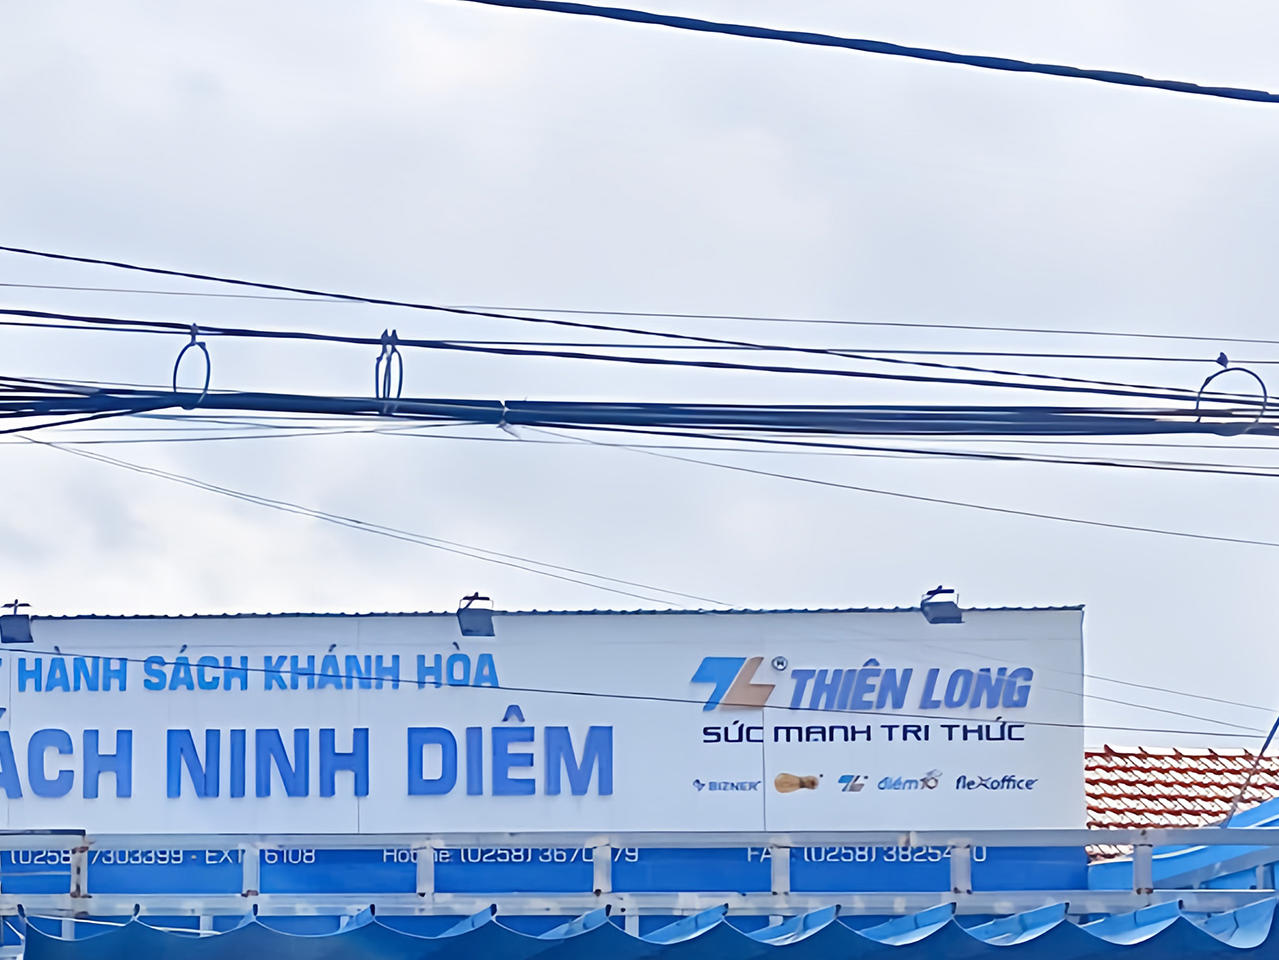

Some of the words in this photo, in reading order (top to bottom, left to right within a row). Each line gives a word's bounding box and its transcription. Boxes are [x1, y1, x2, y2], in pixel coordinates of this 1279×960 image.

[18, 645, 127, 693] HÀNH
[143, 644, 248, 691] SÁCH
[264, 643, 400, 691] KHÁNH
[417, 641, 499, 688] HÒA
[790, 657, 913, 710] THIÊN
[919, 667, 1034, 709] LONG
[881, 724, 929, 741] TRI
[940, 717, 1025, 741] THỨC
[167, 726, 369, 798] NINH
[407, 704, 613, 796] DIÊM
[538, 847, 639, 863] 367079
[883, 847, 987, 862] 382540
